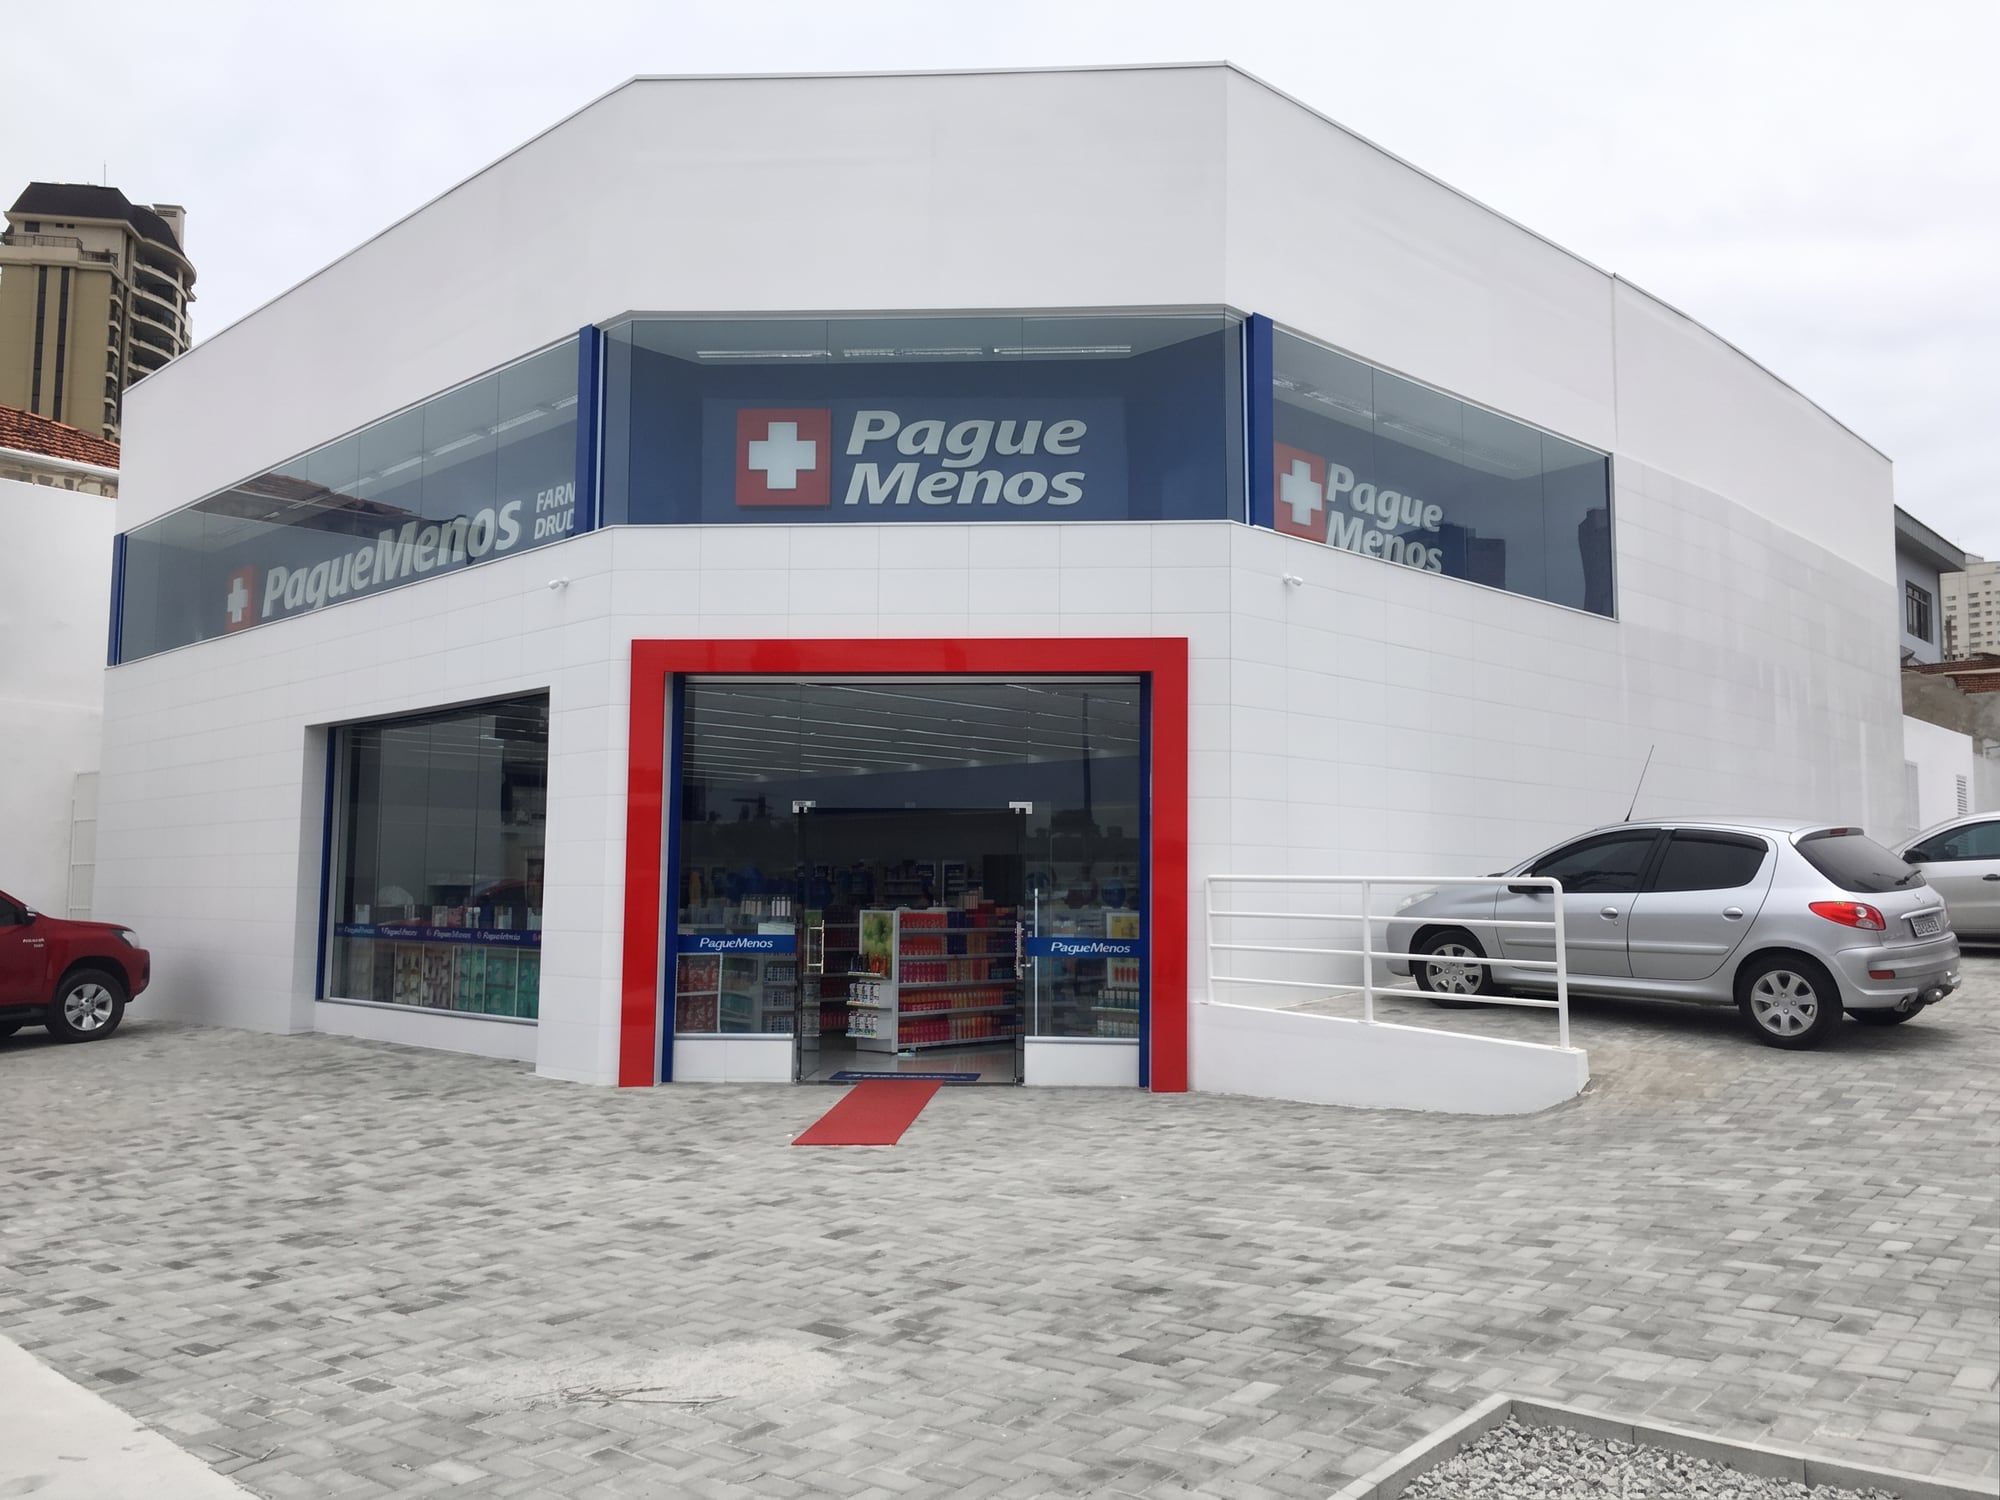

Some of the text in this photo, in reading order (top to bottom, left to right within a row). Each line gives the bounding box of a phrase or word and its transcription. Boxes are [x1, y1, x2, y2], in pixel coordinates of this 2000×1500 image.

[846, 410, 1087, 468] Pague
[844, 462, 1086, 505] Menos
[1326, 462, 1443, 532] Pague
[262, 500, 522, 618] PagueMenos
[1325, 510, 1443, 574] Menos
[699, 937, 774, 951] PagueMenos
[1050, 941, 1132, 956] PagueMenos
